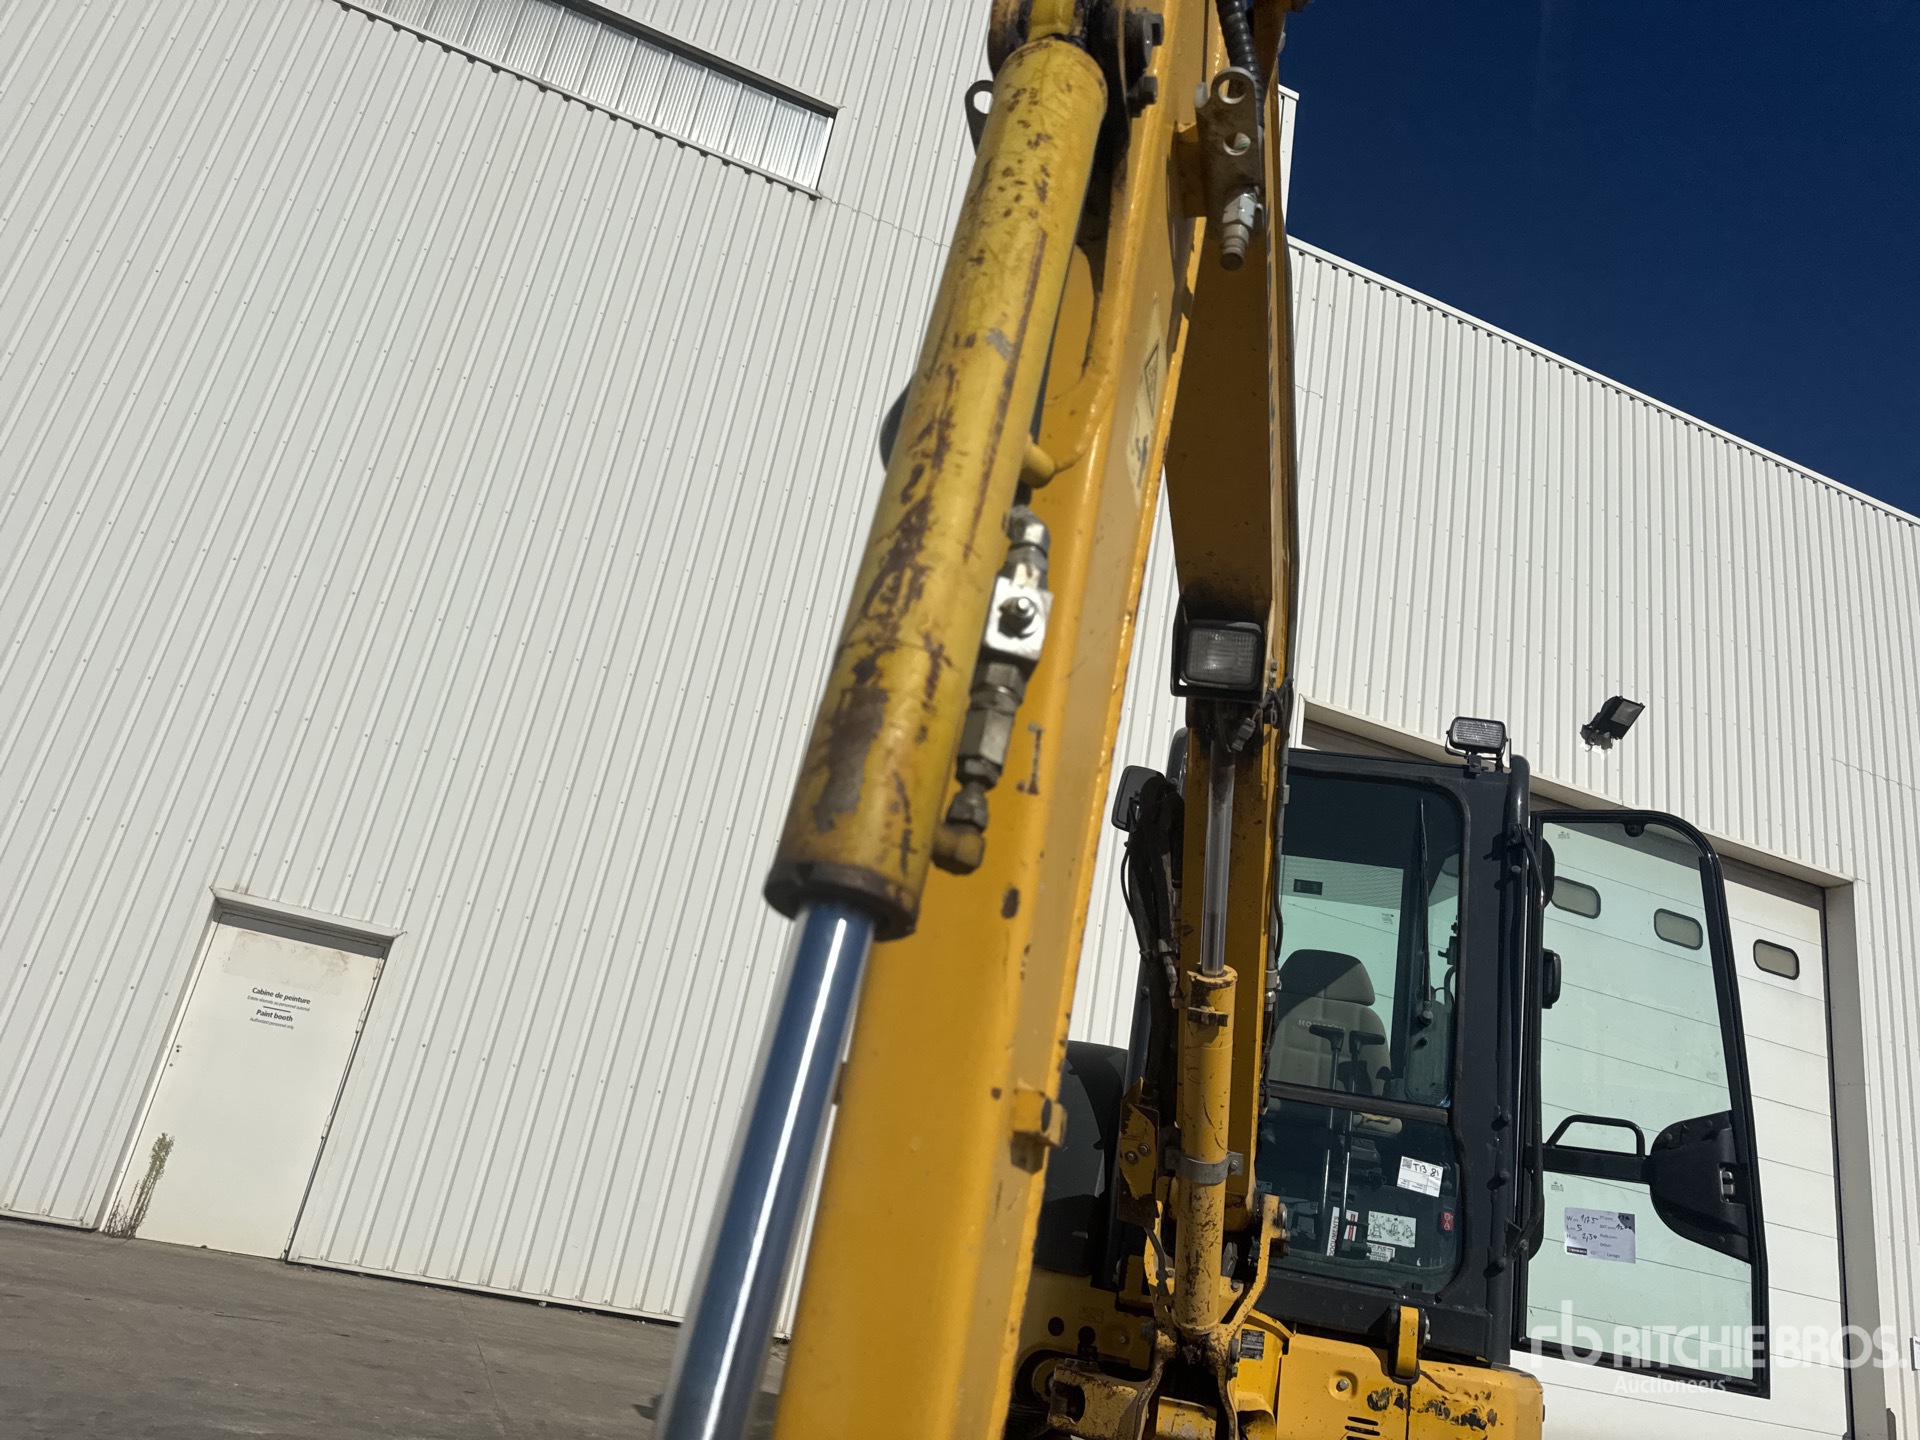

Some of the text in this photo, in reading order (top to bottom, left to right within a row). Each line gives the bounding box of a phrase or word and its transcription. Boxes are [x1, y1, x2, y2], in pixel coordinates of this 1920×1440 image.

[252, 987, 274, 997] Cabine
[283, 995, 311, 1005] peinture
[256, 1009, 294, 1022] Paint booth
